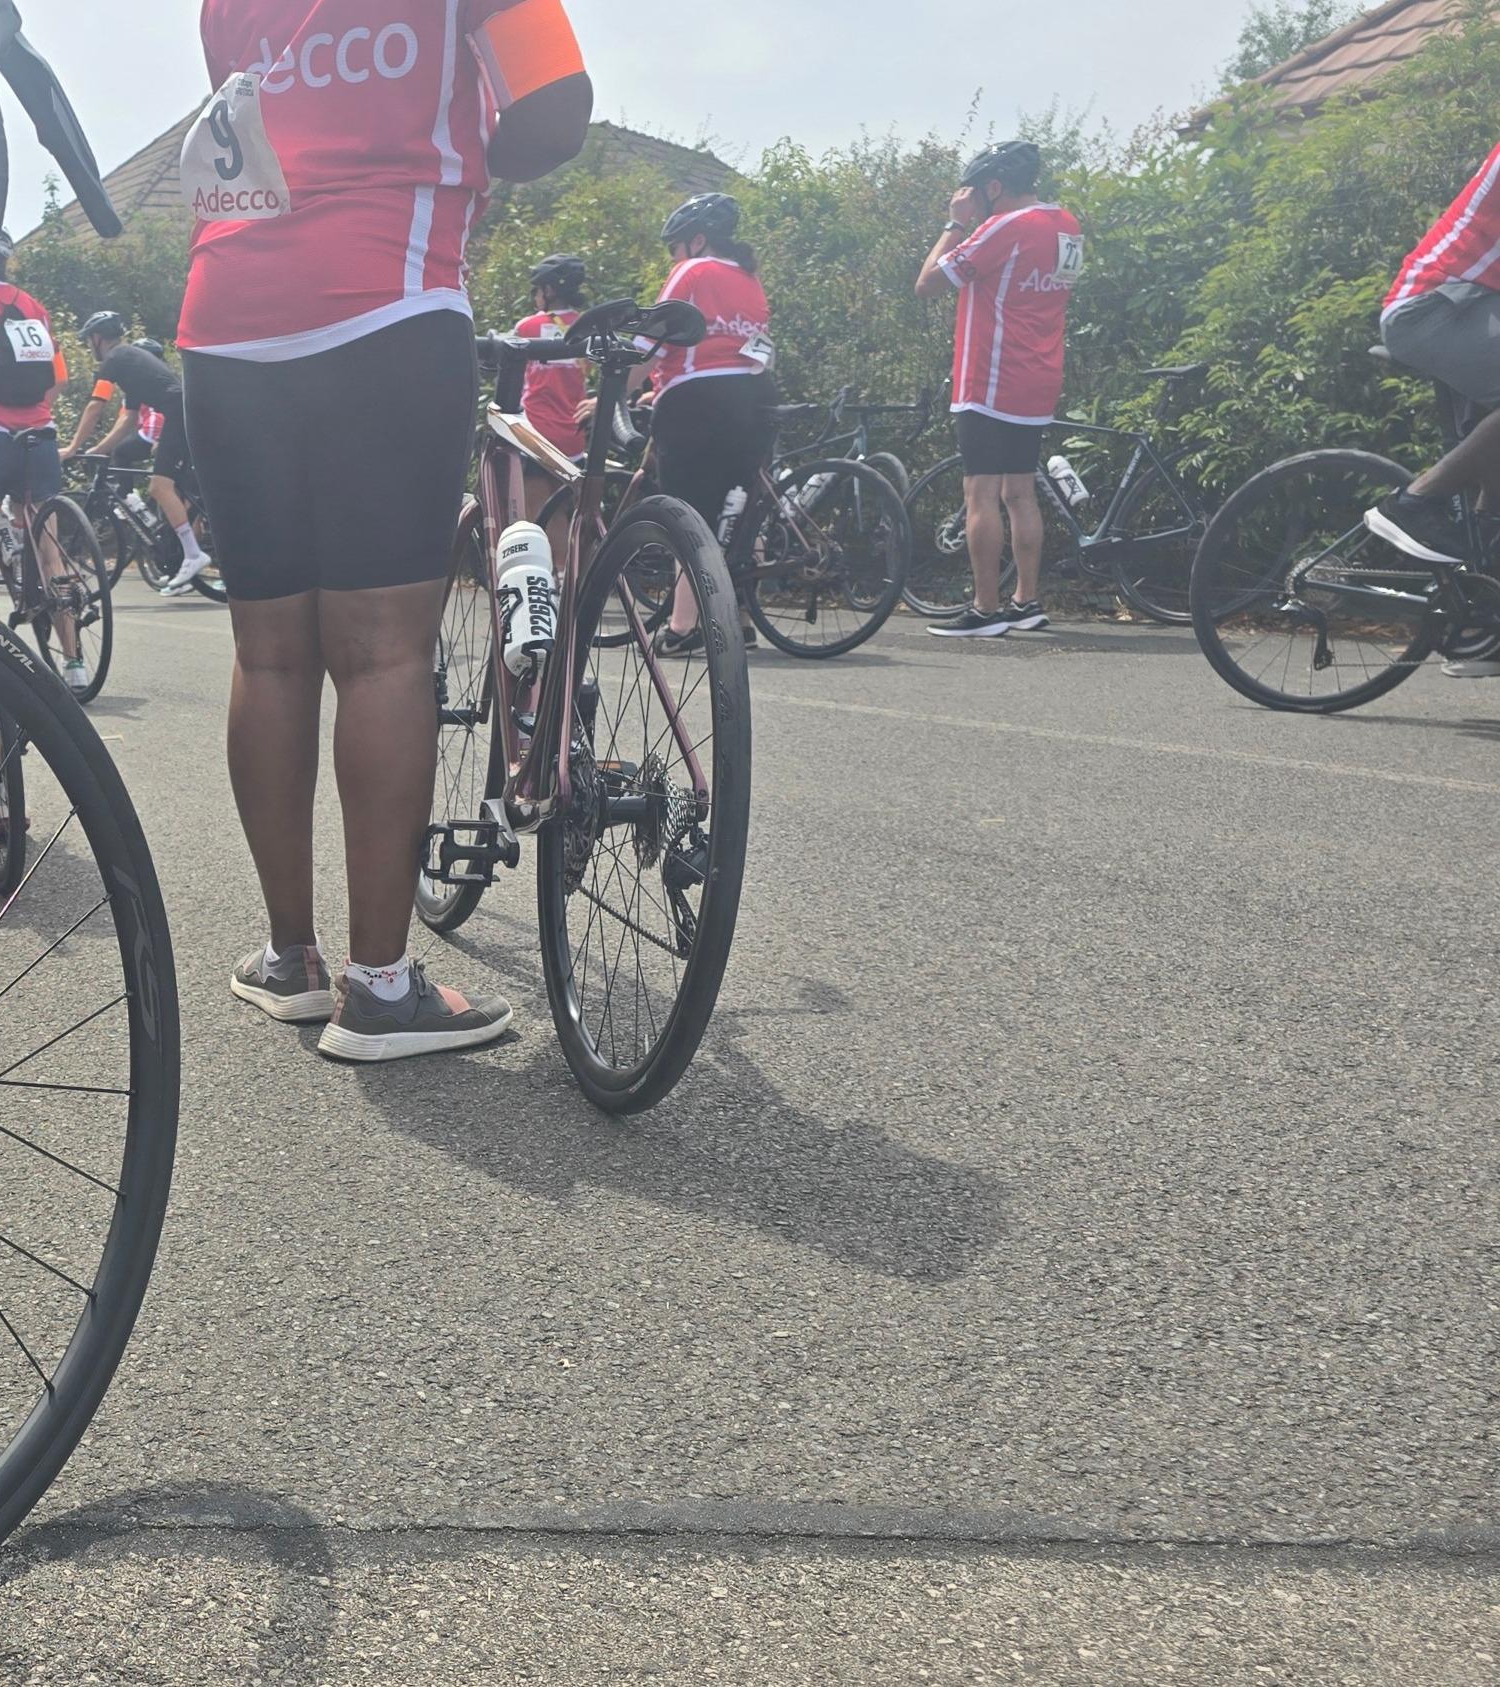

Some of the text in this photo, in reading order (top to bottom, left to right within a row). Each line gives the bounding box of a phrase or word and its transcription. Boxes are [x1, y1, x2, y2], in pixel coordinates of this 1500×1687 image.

[208, 99, 244, 181] 9
[192, 184, 280, 213] Adecco
[14, 326, 43, 348] 16
[526, 575, 554, 639] 226ERS
